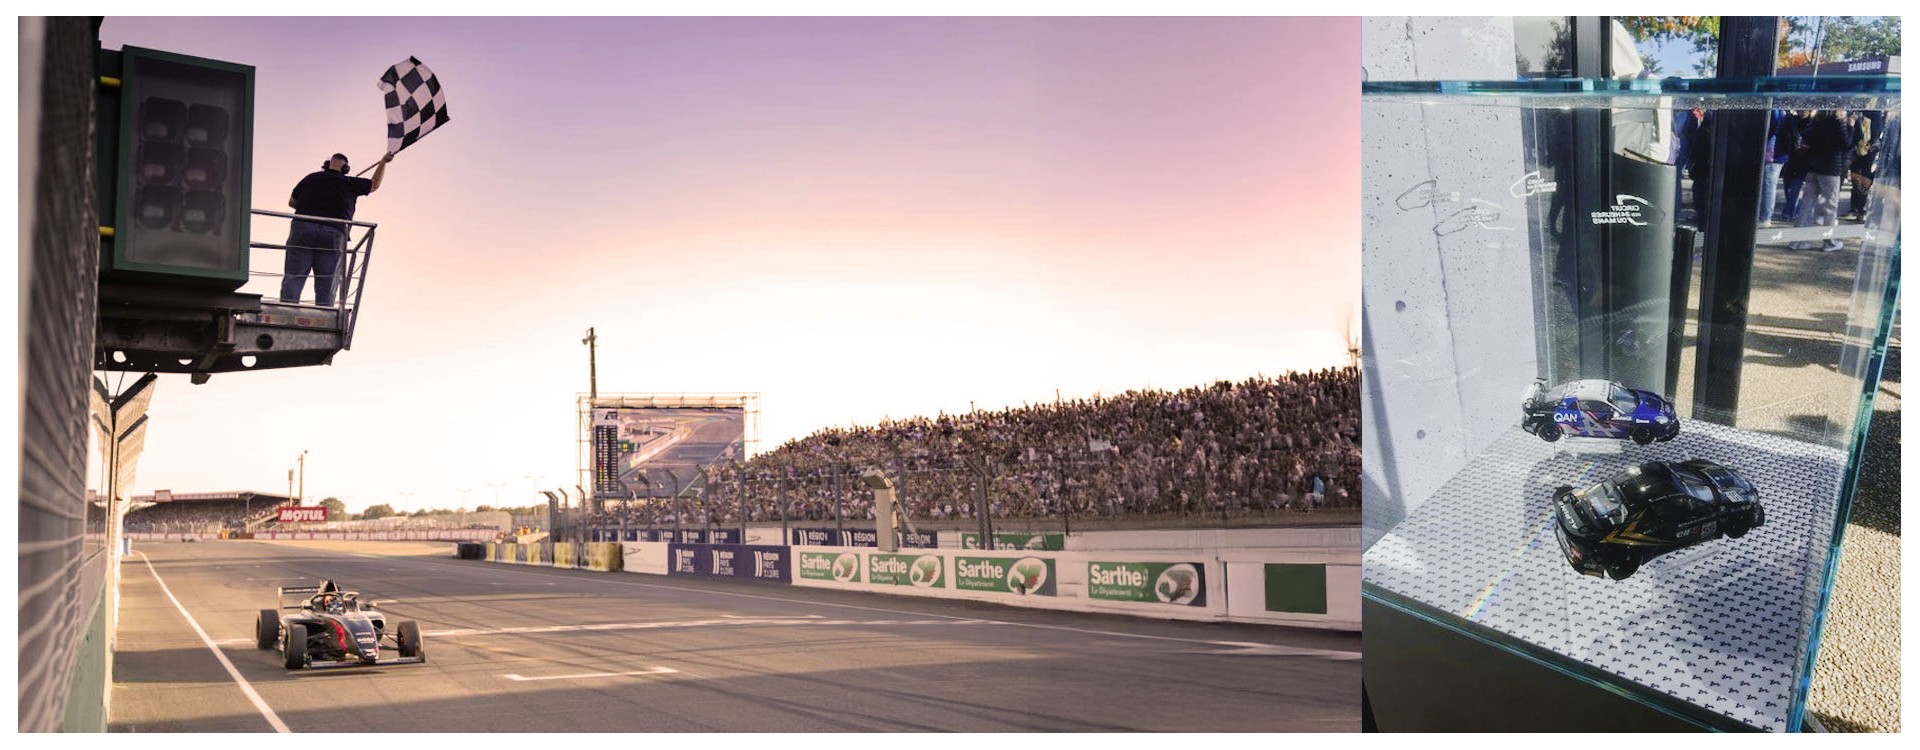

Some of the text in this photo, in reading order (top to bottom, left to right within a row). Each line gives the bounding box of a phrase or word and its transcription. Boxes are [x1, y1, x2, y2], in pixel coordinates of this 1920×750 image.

[1848, 61, 1881, 72] SAMSUNG
[1553, 412, 1578, 423] QAN
[280, 509, 325, 521] MOTUL
[853, 531, 876, 543] RÉGION
[801, 554, 831, 570] Sarthe
[871, 556, 908, 574] Sarthe
[958, 559, 1004, 579] Sarthe
[1090, 564, 1142, 587] Sarthe
